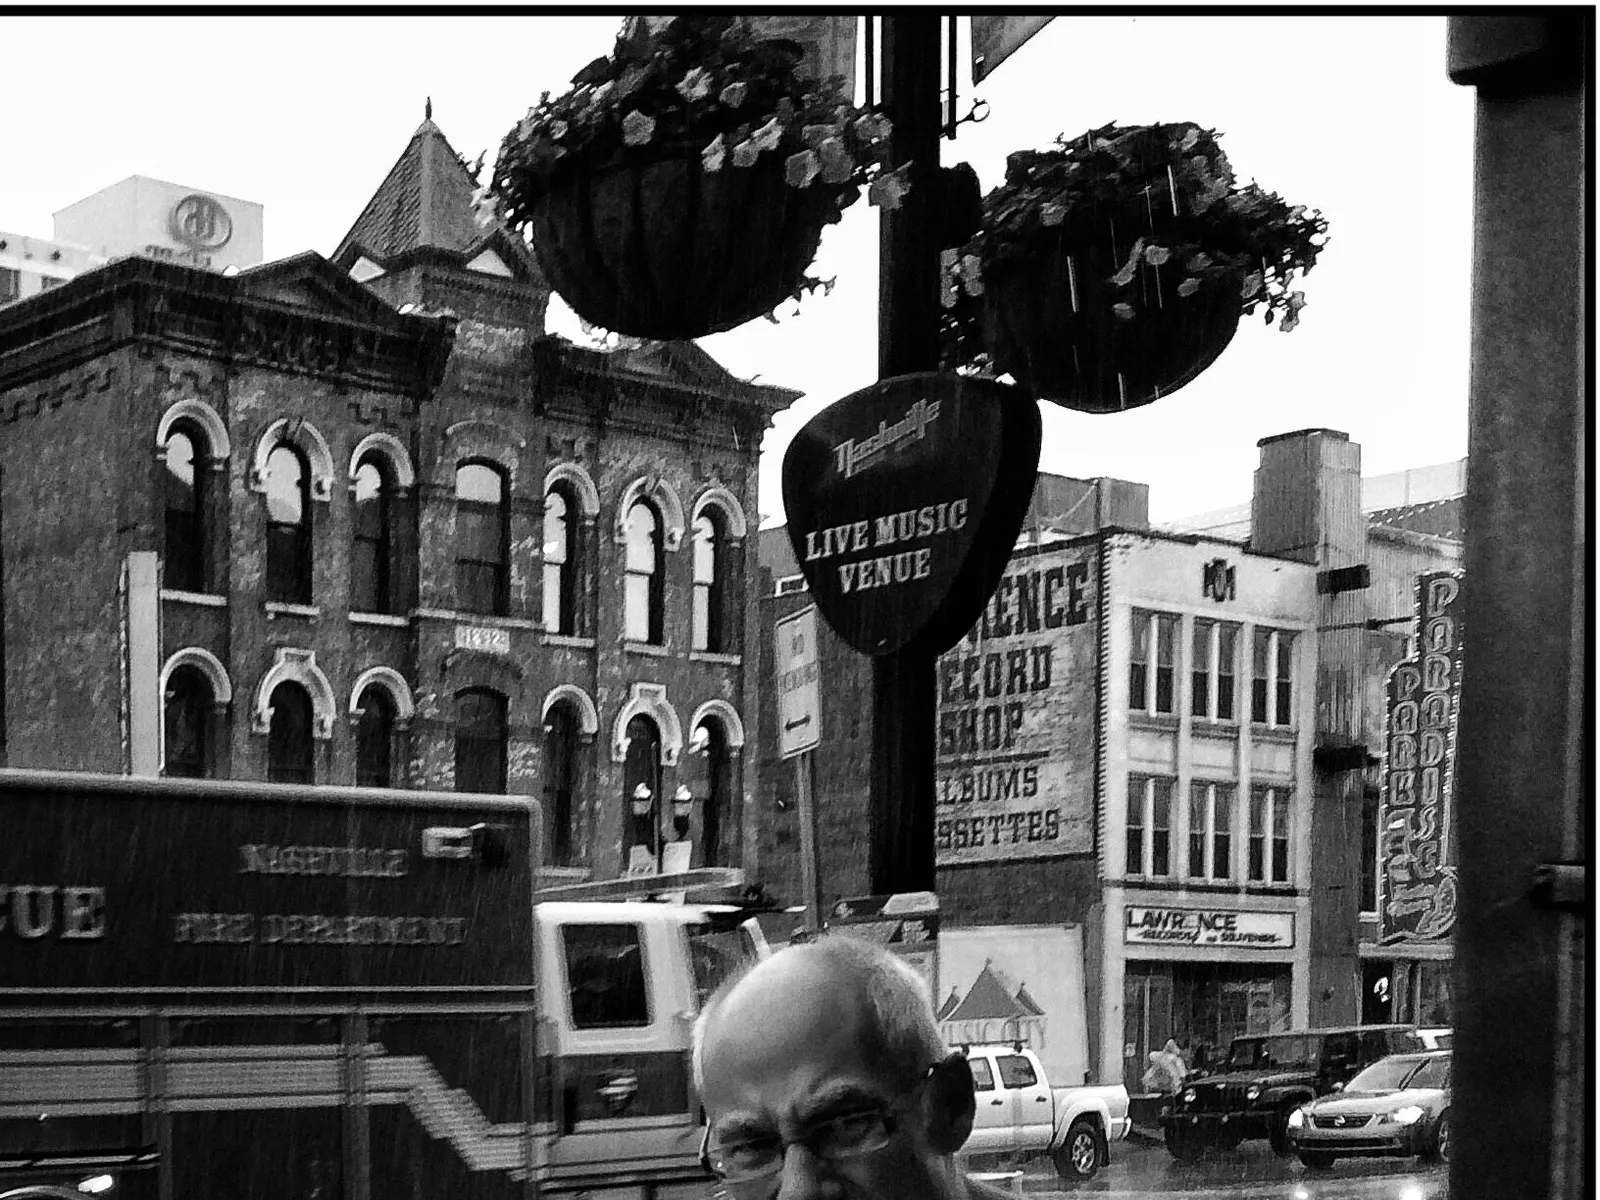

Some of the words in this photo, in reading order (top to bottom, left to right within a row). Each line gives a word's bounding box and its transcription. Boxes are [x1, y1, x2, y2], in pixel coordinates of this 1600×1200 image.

[805, 520, 869, 562] LIVE
[874, 498, 969, 548] MUSIC
[838, 548, 932, 595] VENUE
[968, 562, 1089, 642] ENCE
[940, 702, 1024, 757] SHOP
[1389, 666, 1421, 807] PARK
[1411, 577, 1460, 879] PARADISE
[937, 766, 1039, 806] LBUMS
[173, 912, 255, 943] FIRE
[260, 914, 468, 945] DEPARTMENT
[1127, 909, 1238, 932] LAWRNCE
